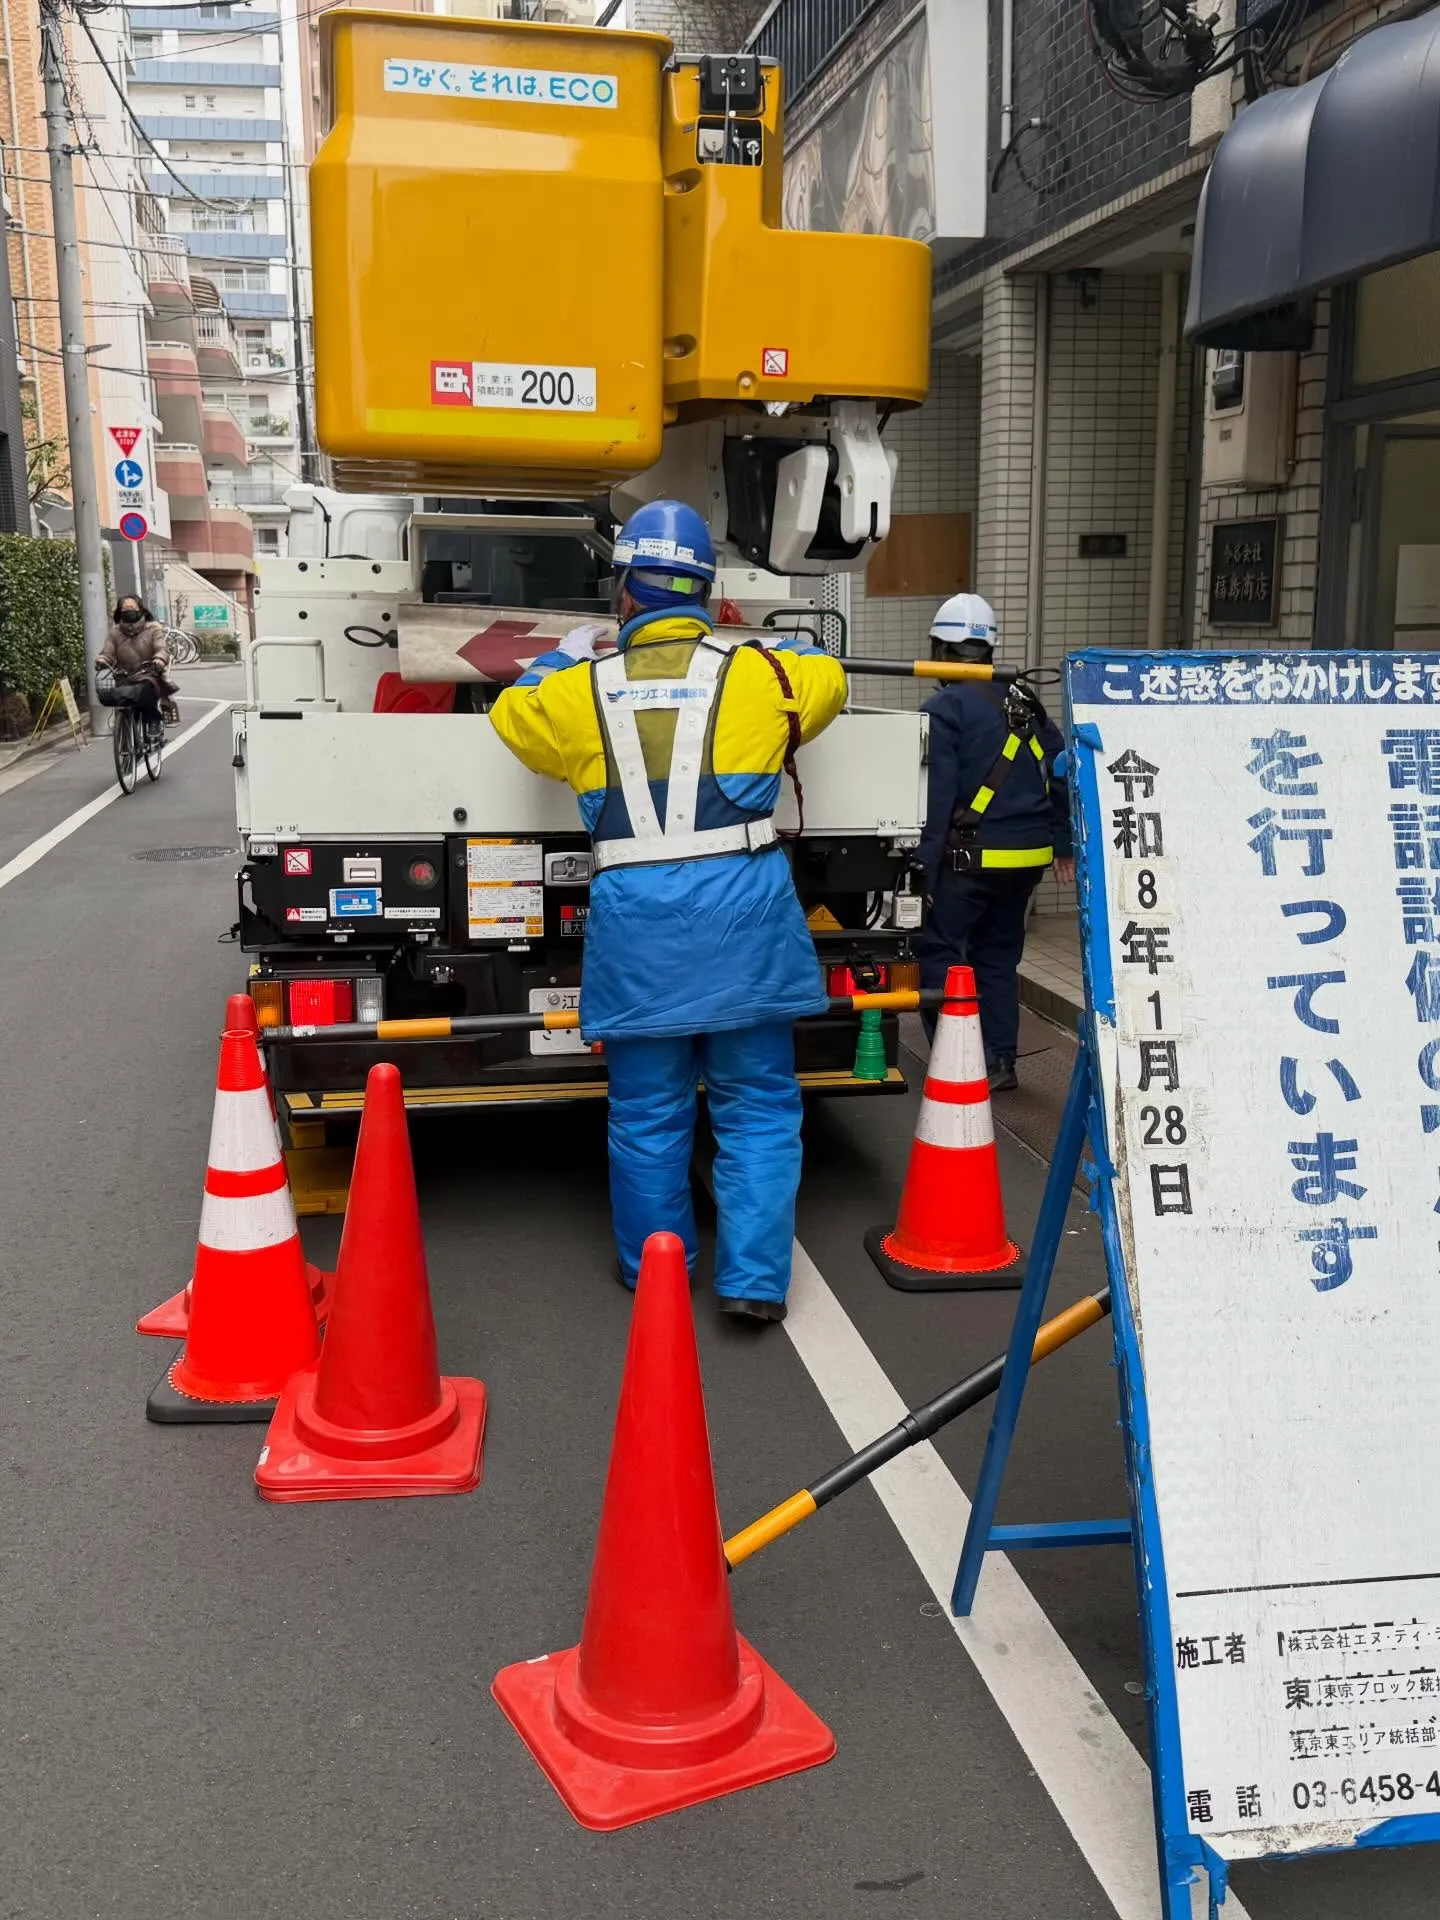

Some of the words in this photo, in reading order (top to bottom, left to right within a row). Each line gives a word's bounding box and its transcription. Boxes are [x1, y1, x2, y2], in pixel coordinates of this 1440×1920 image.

[521, 370, 575, 406] 200
[563, 920, 588, 935] 最大
[1246, 727, 1378, 1292] を行っています
[1176, 1632, 1246, 1670] 施工者
[1293, 1726, 1440, 1752] 東京東エリア統括部
